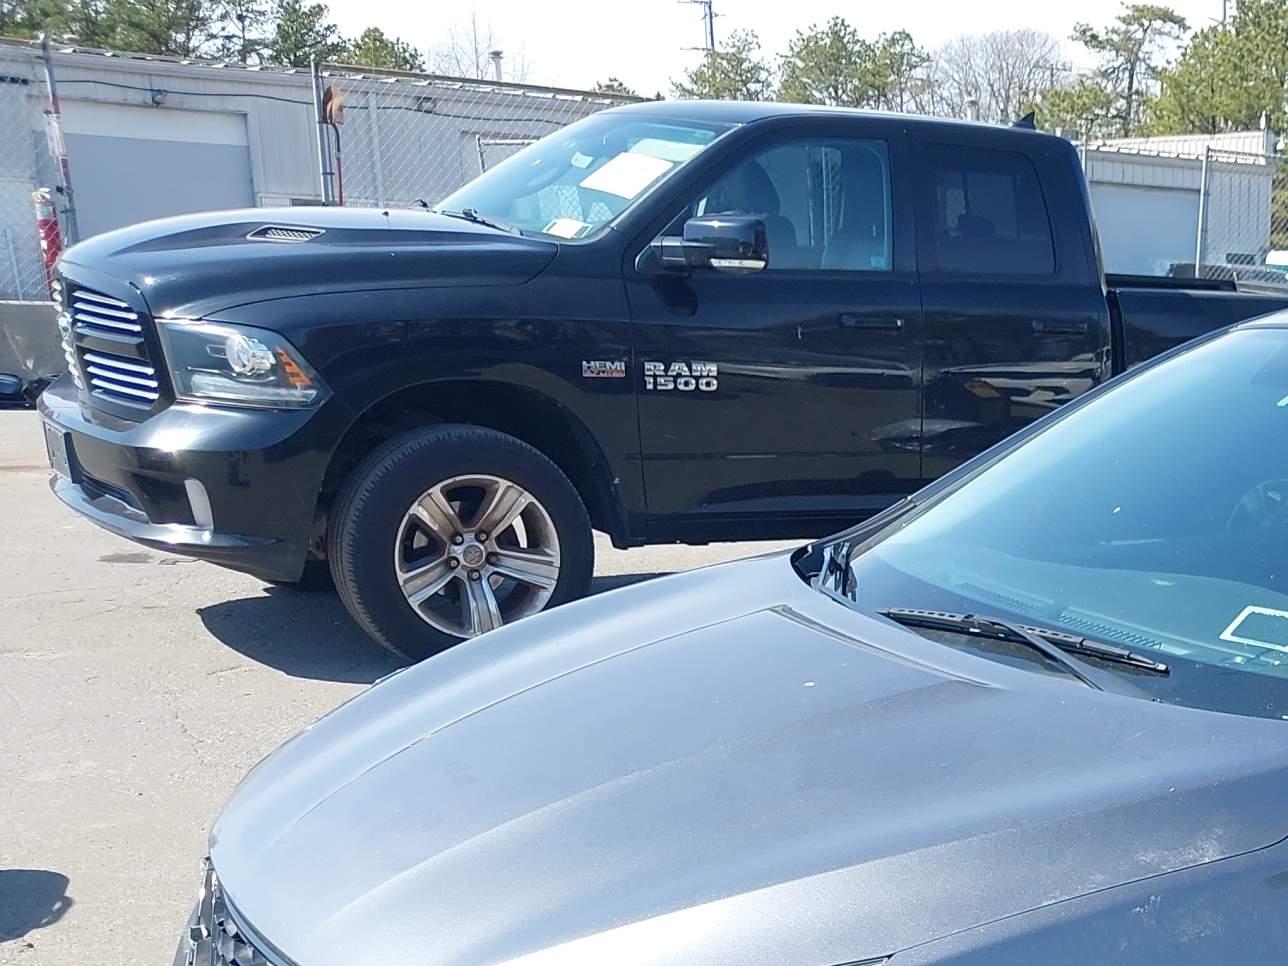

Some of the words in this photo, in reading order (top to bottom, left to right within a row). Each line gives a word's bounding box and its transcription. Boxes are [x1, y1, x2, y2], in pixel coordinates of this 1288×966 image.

[582, 361, 625, 370] HEMI
[644, 362, 718, 376] RAM
[644, 377, 718, 391] 1500
